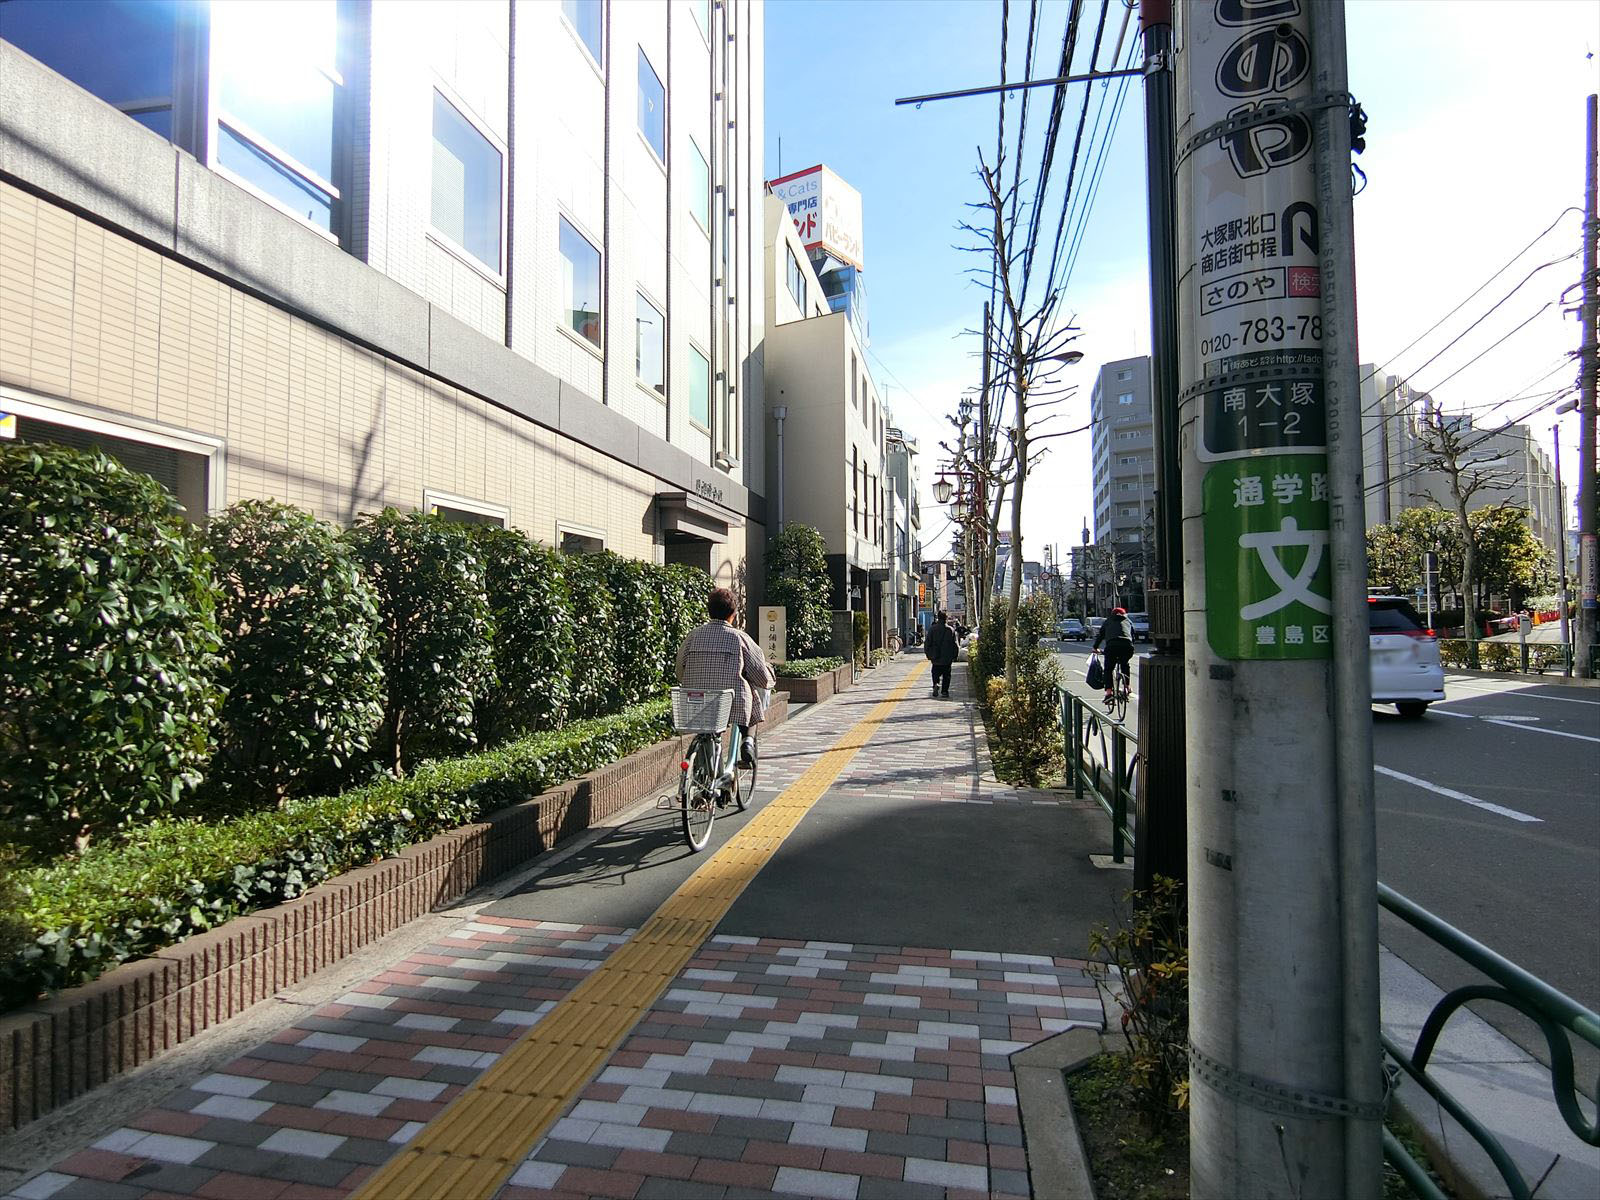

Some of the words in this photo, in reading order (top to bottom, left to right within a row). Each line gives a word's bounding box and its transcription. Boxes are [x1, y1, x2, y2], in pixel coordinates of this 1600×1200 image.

[1214, 0, 1313, 179] のや
[788, 180, 818, 198] Cats
[1201, 212, 1276, 252] 大塚駅北口
[1201, 237, 1277, 276] 商店街中程
[1206, 275, 1275, 307] さのや
[1223, 382, 1315, 413] 南大塚
[1256, 624, 1329, 645] 豊島区
